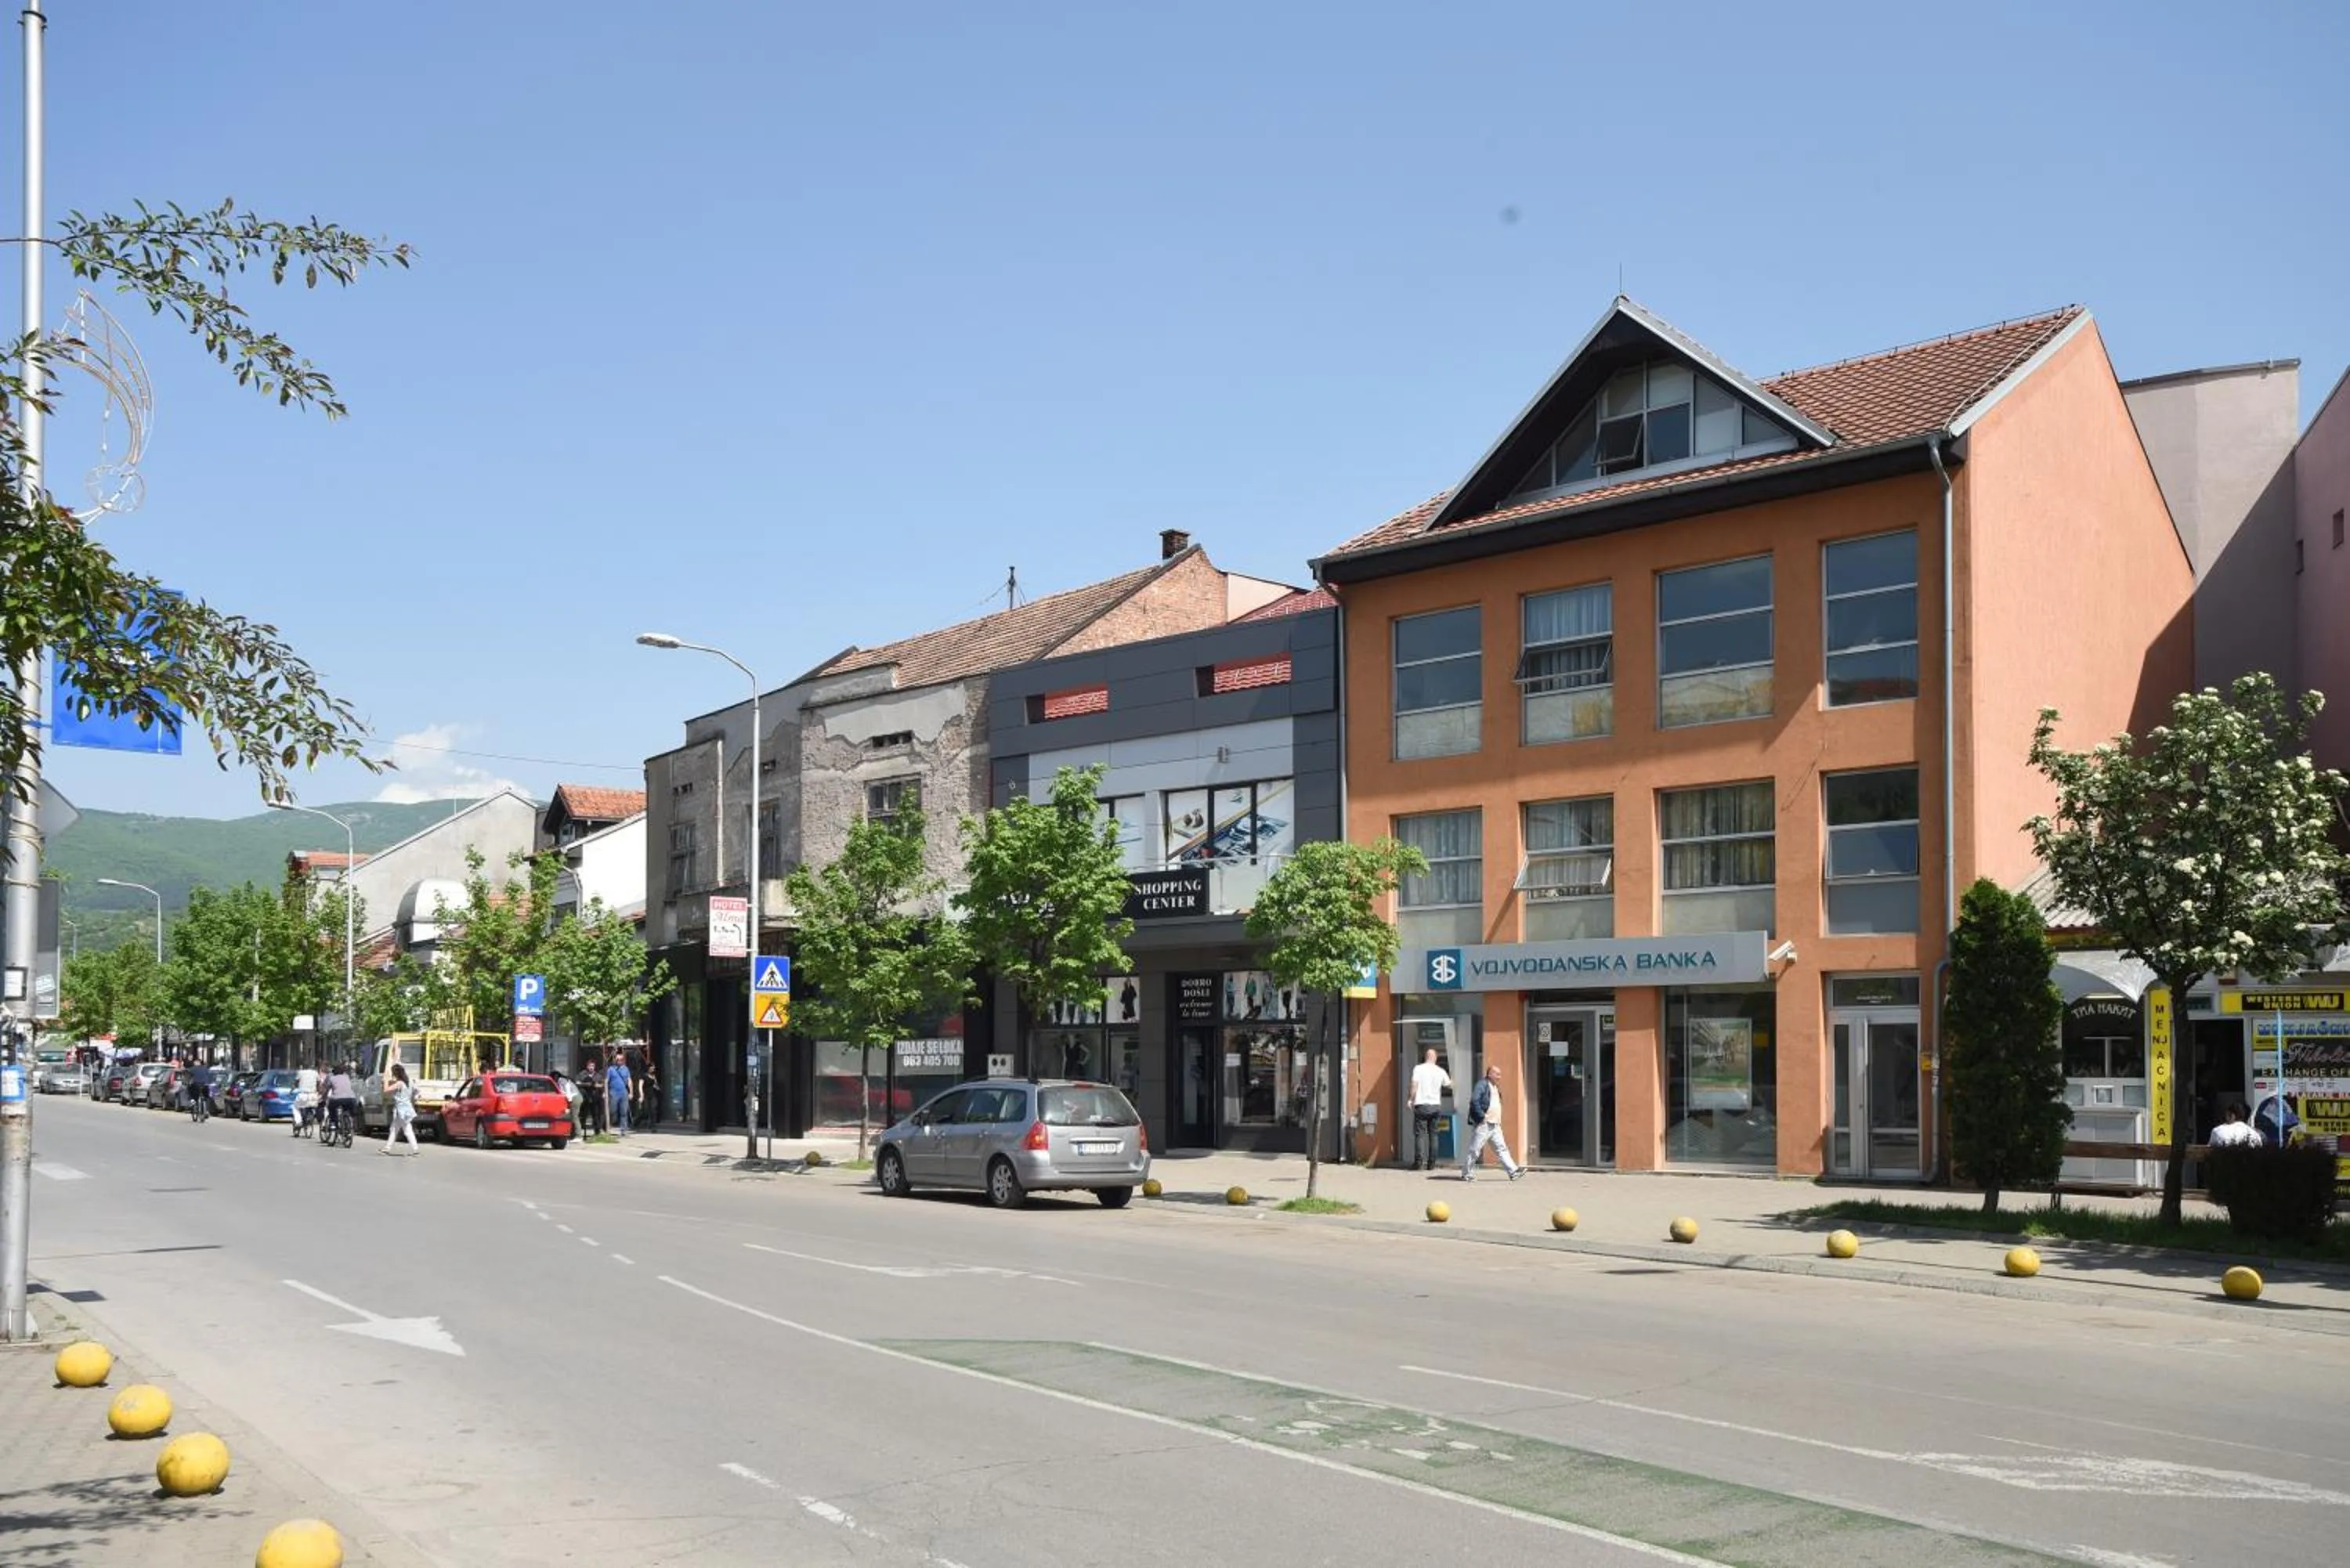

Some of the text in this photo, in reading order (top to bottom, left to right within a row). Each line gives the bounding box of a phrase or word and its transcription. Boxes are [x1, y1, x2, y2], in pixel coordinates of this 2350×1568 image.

[1134, 879, 1202, 895] SHOPPING
[1144, 895, 1195, 910] CENTER
[1636, 950, 1716, 970] BANKA
[897, 1040, 925, 1054] IZDAJE
[927, 1041, 938, 1054] SE
[2261, 1068, 2350, 1077] EXHANGE OF
